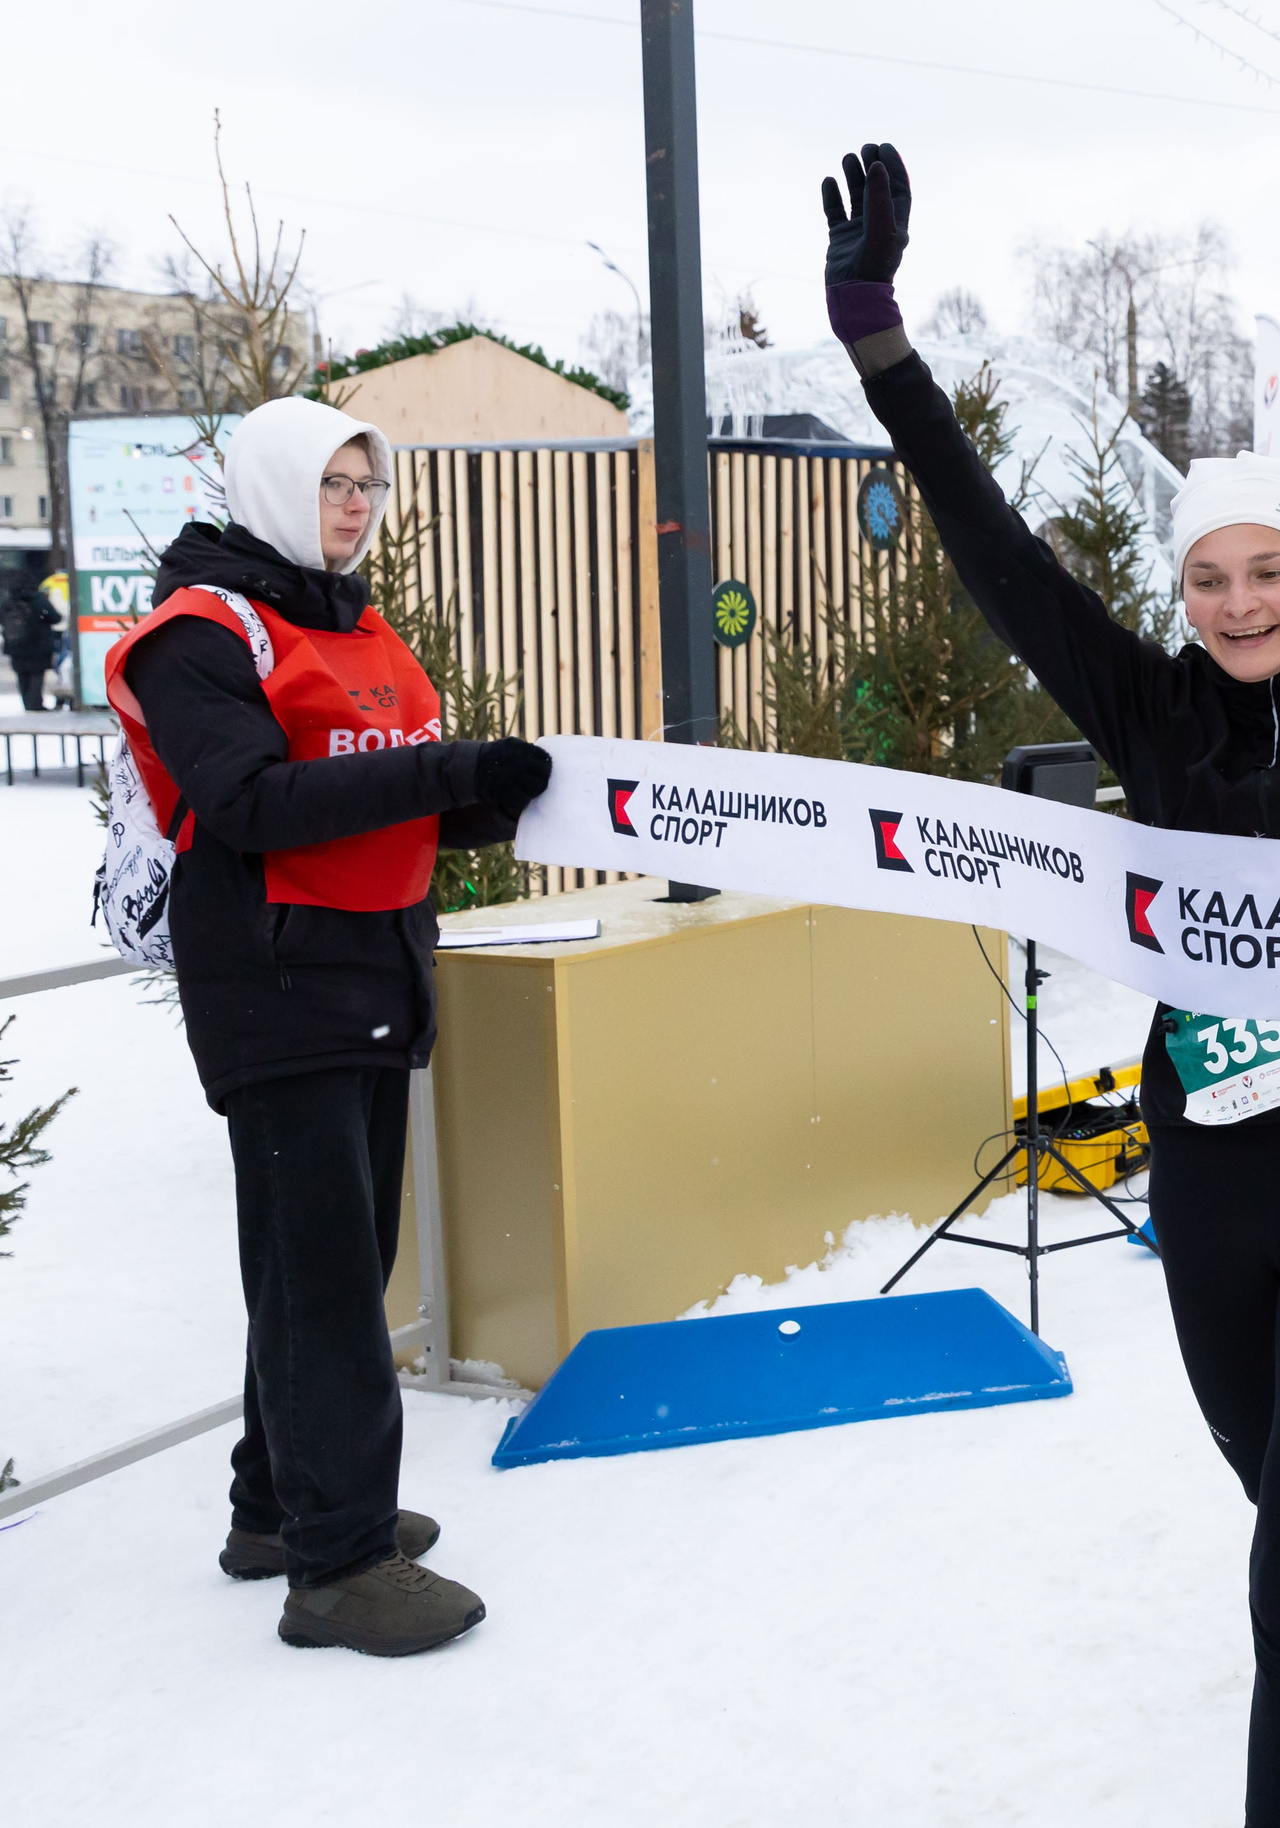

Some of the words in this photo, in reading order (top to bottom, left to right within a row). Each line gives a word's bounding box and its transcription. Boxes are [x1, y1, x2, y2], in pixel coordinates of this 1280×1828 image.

[653, 784, 827, 828] КАЛАШНИКОВ
[650, 814, 727, 848] СПОРТ
[916, 816, 1084, 883] КАЛАШНИКОВ
[924, 849, 1001, 888] СПОРТ
